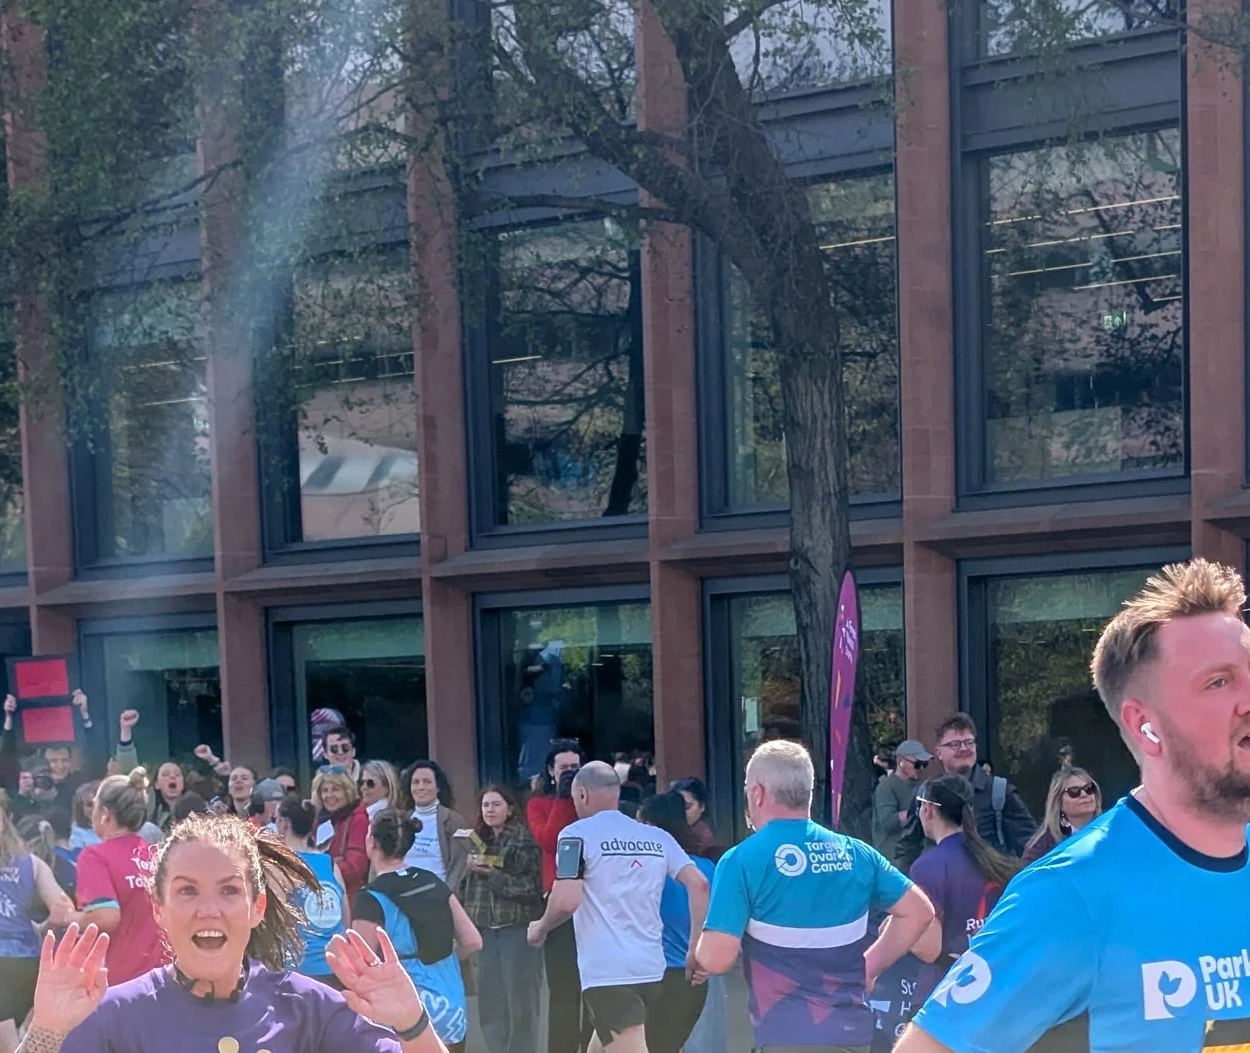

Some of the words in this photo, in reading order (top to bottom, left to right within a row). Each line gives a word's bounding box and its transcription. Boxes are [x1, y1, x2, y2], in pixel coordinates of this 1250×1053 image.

[600, 838, 664, 853] advocate
[804, 841, 847, 853] Targe
[809, 851, 853, 864] Ovarn
[811, 861, 853, 874] Cancer
[1205, 979, 1243, 1011] UK
